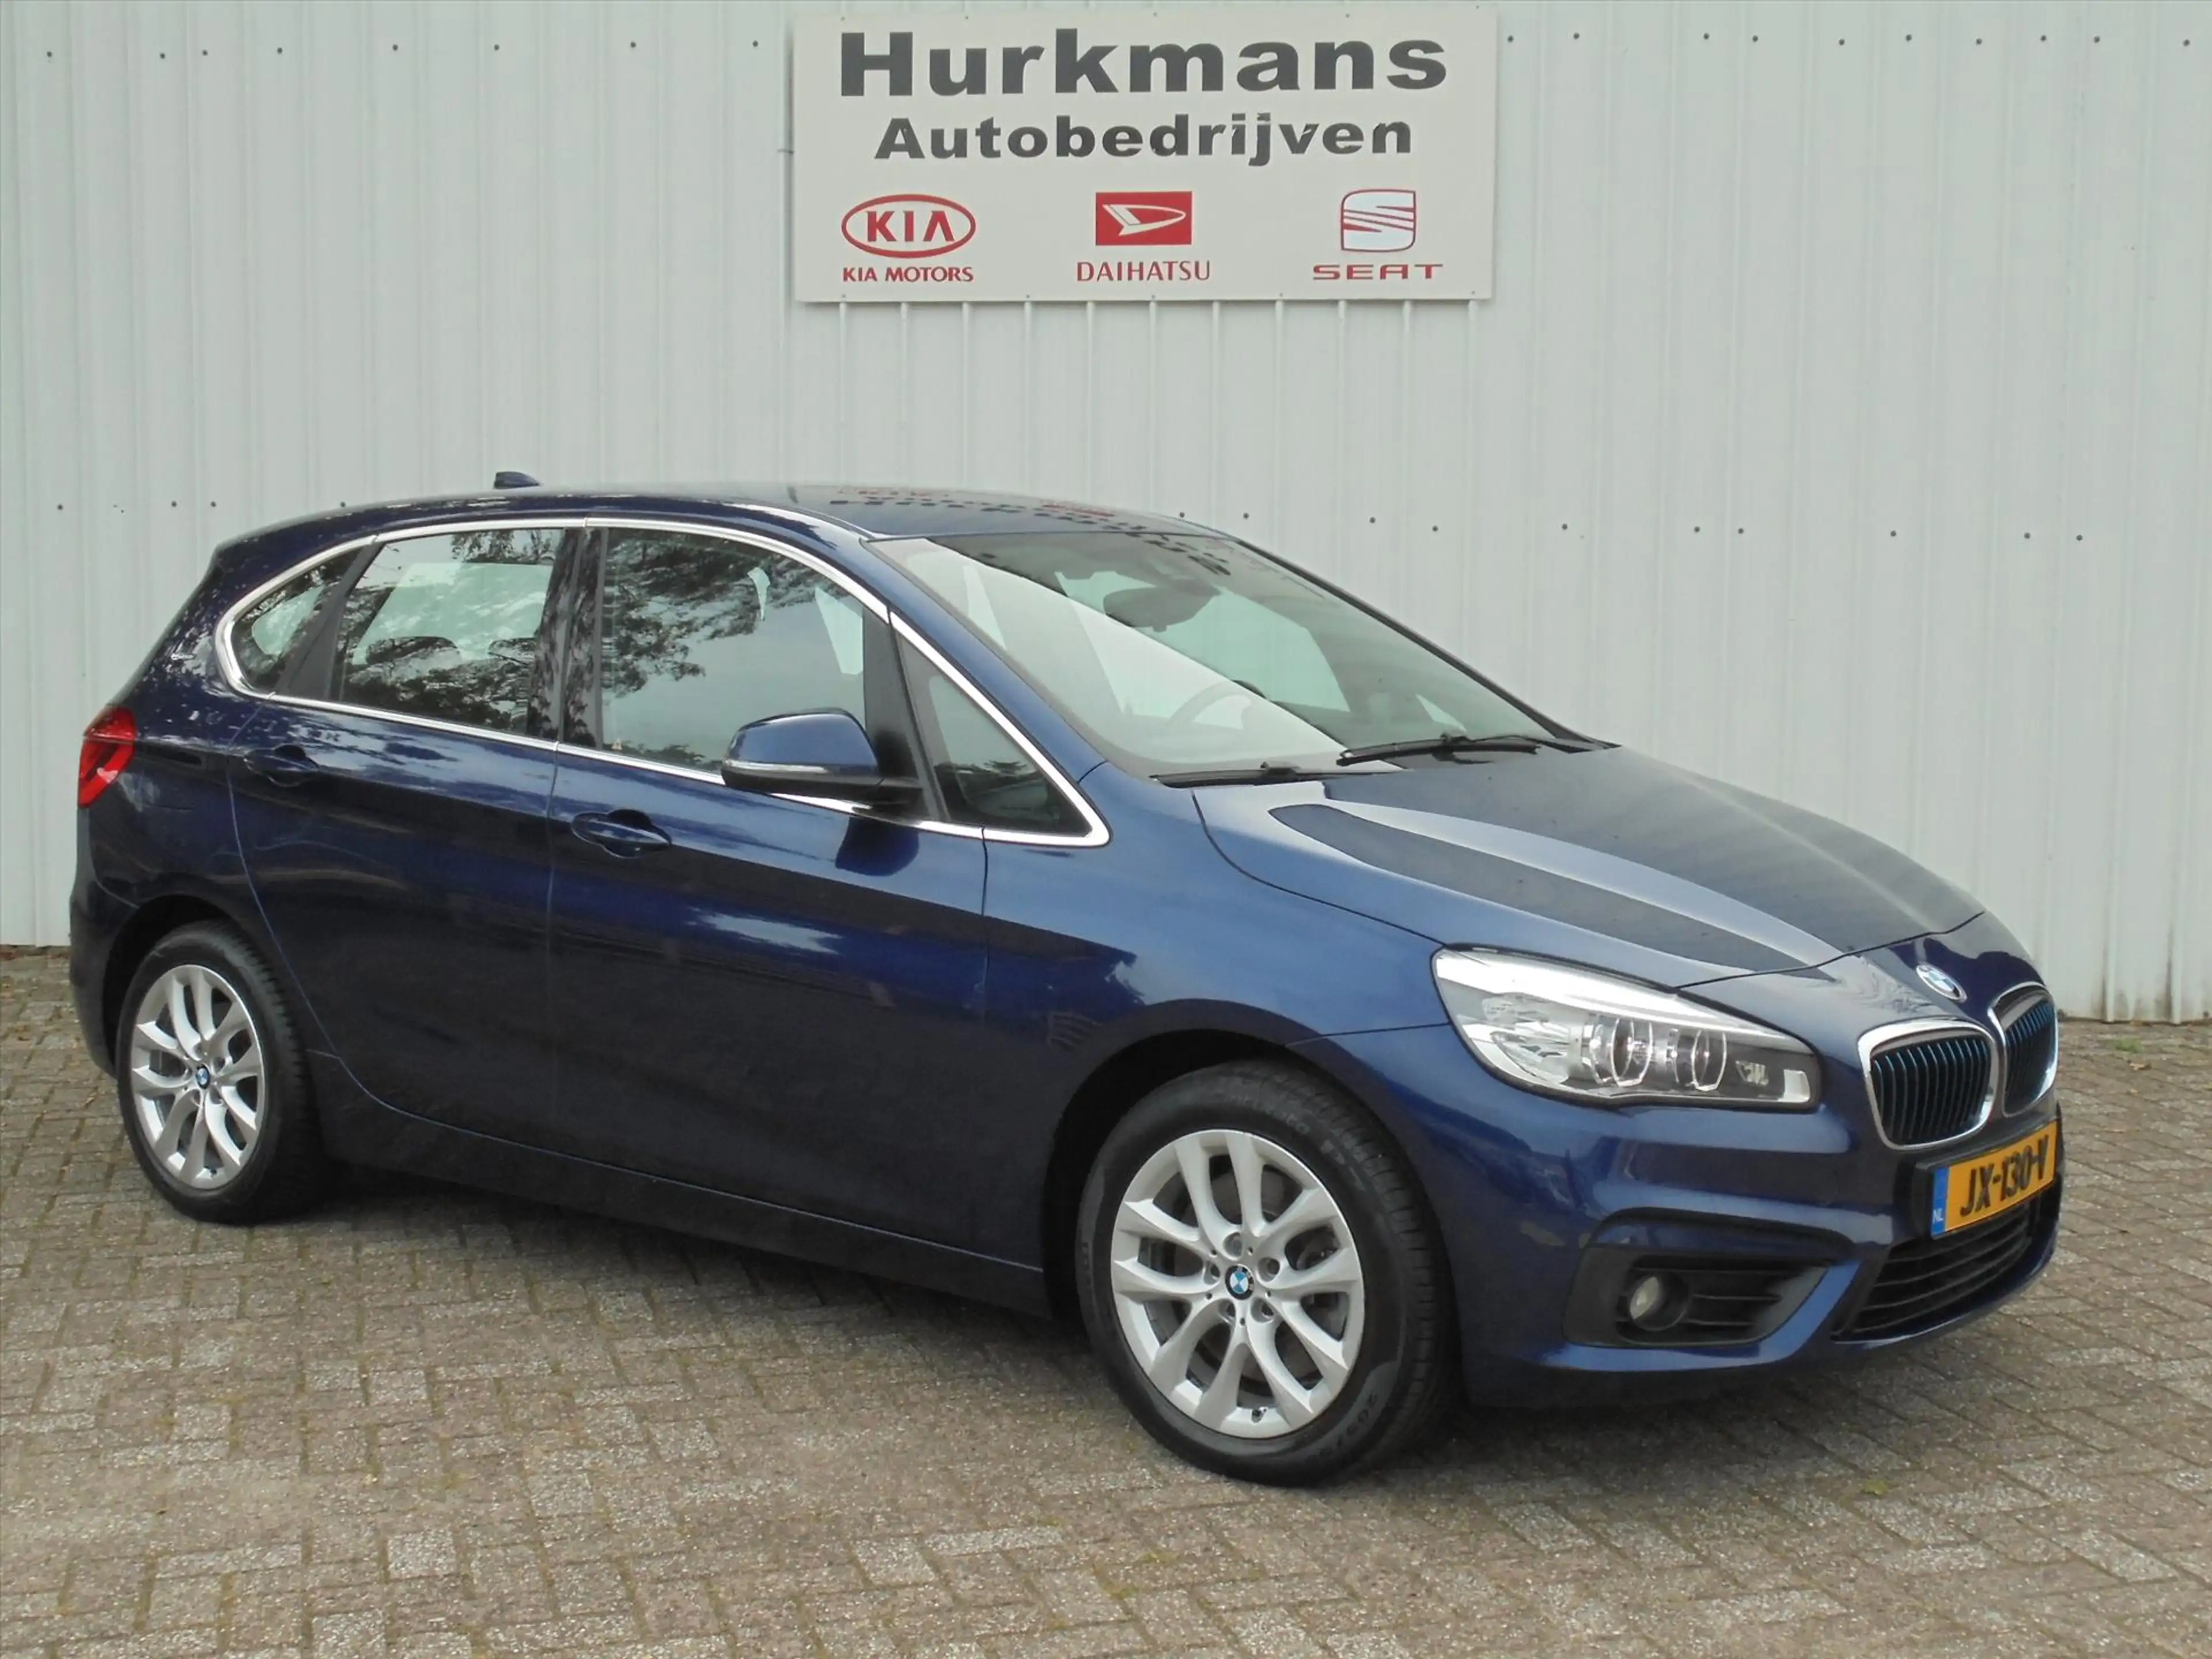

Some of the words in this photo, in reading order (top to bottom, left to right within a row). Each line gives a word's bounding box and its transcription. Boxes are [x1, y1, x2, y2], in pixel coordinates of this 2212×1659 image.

[841, 28, 1446, 96] Hurkmans
[874, 113, 1411, 166] Autobedrijven
[867, 210, 954, 242] KIA
[843, 267, 877, 281] KIA
[885, 267, 974, 282] MOTORS
[1077, 260, 1210, 281] DAIHATSU
[1313, 264, 1444, 280] SEAT
[1960, 1134, 2049, 1217] JX-130-V
[1932, 1207, 1944, 1224] NL
